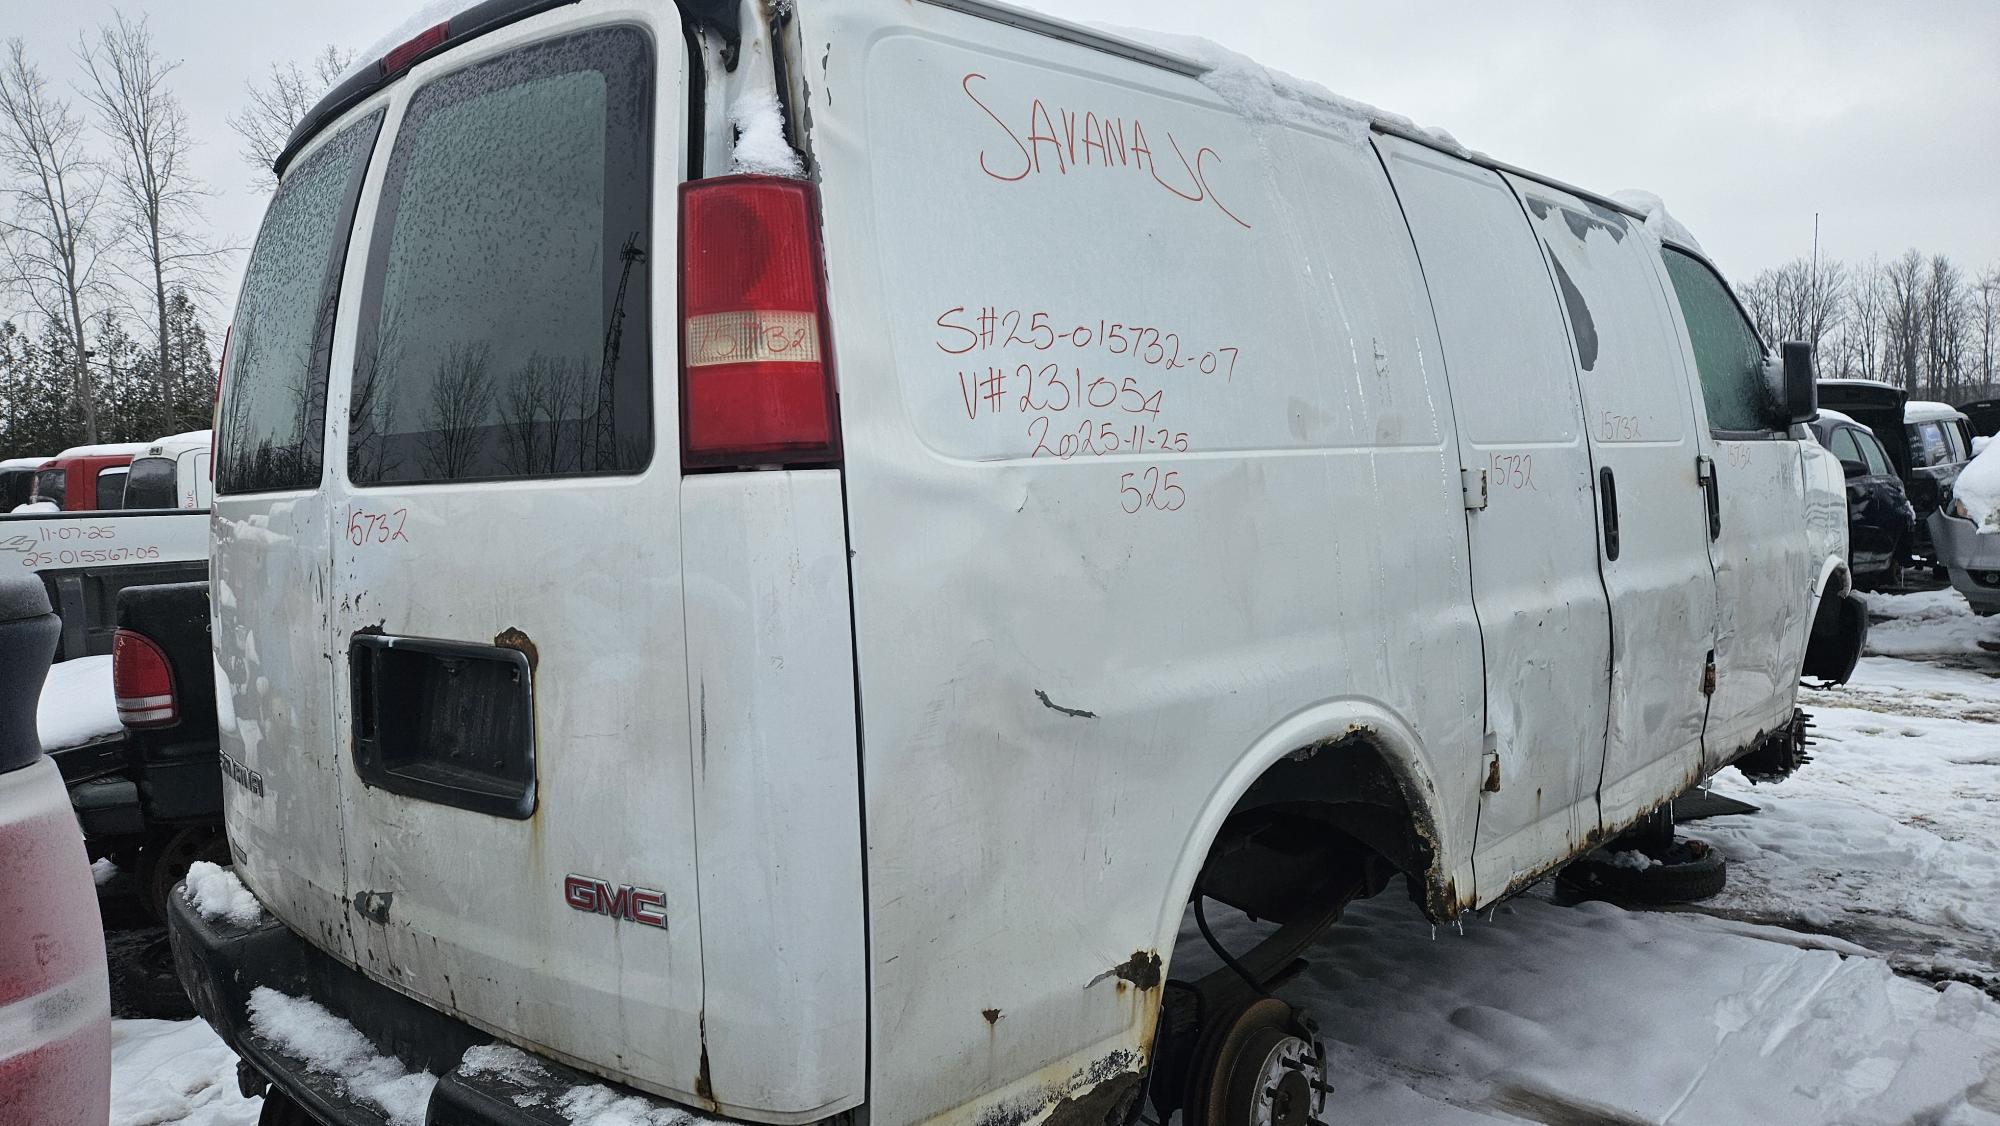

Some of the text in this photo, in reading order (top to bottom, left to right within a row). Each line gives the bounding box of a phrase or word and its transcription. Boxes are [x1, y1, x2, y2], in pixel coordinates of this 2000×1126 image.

[963, 73, 1152, 181] SAVANA
[1027, 416, 1189, 459] 2025-11-25
[1600, 408, 1642, 440] 15732
[1120, 466, 1186, 514] 525
[1489, 451, 1538, 491] 15732
[564, 872, 668, 930] GMC
